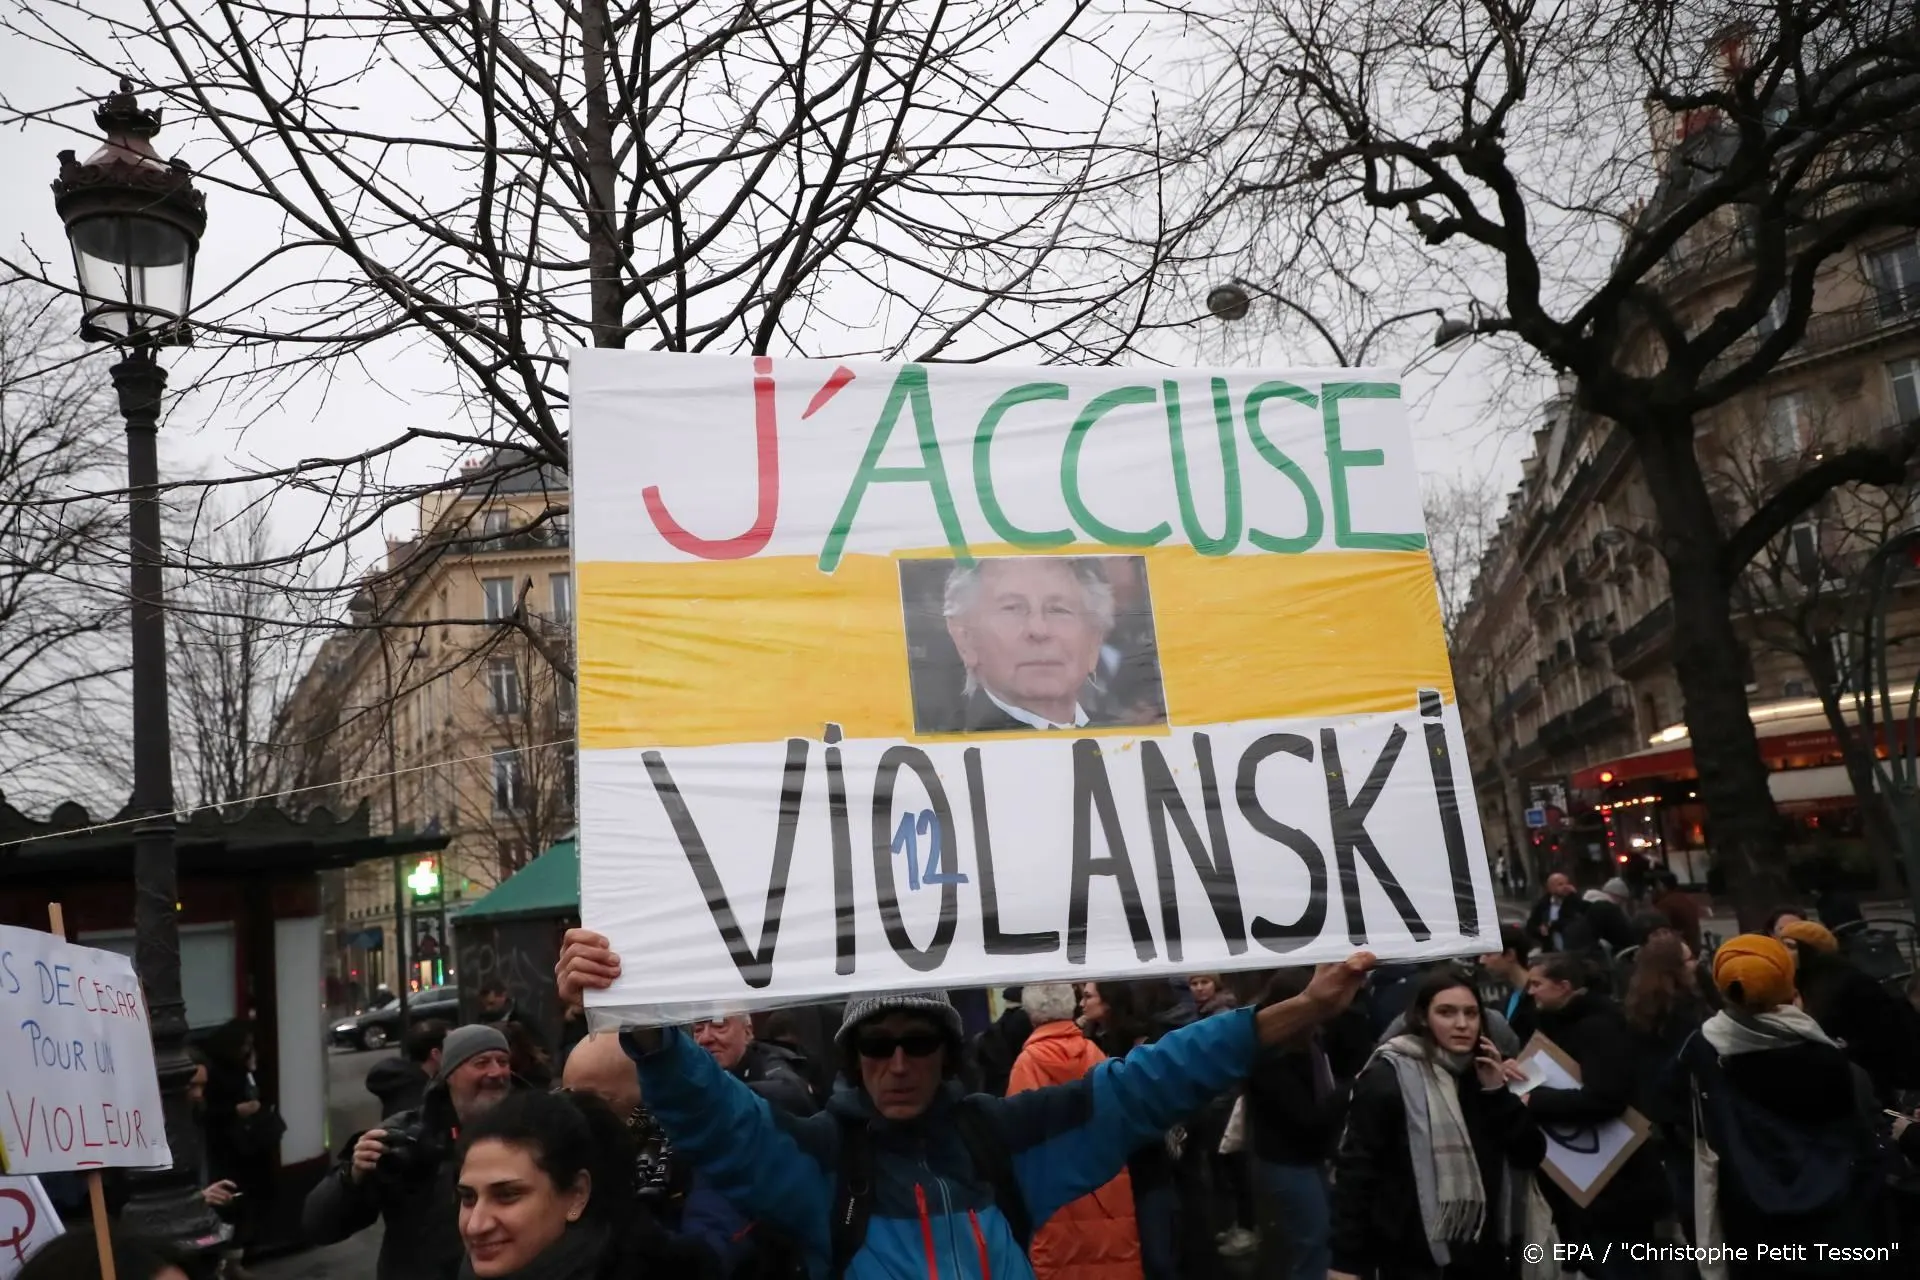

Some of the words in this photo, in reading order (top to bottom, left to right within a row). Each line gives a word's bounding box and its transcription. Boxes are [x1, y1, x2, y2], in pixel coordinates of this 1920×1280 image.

[890, 808, 968, 892] 12
[34, 960, 75, 1006] DE
[21, 1019, 87, 1072] POUR
[6, 1090, 147, 1158] VIOLEUR
